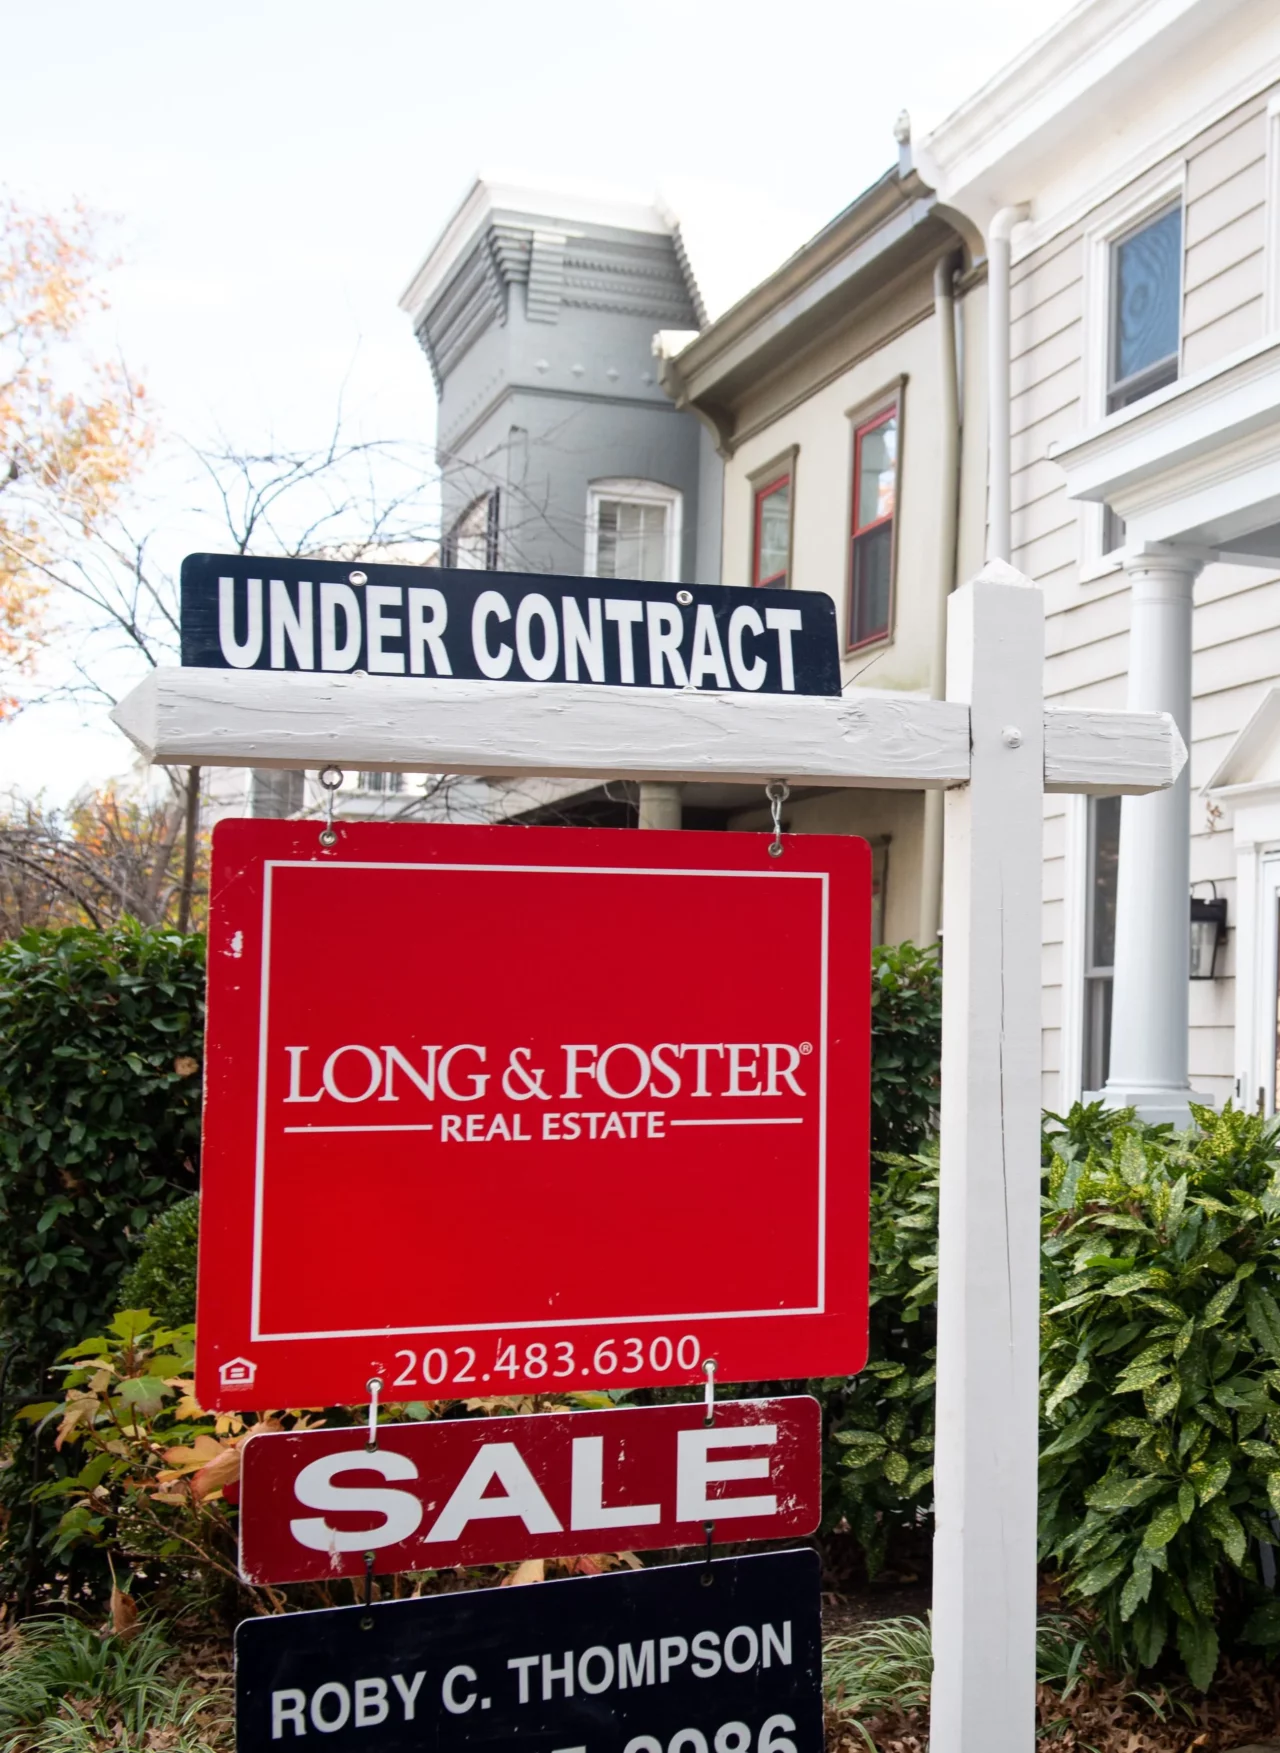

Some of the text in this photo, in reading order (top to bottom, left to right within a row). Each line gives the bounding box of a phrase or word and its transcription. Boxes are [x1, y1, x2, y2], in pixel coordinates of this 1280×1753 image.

[218, 577, 803, 691] UNDER CONTRACT
[283, 1044, 491, 1103] LONG
[502, 1047, 553, 1101] &
[441, 1111, 666, 1143] REAL ESTATE
[392, 1334, 701, 1387] 202.483.6300
[289, 1424, 778, 1552] SALE
[271, 1620, 793, 1739] ROBY C. THOMPSON
